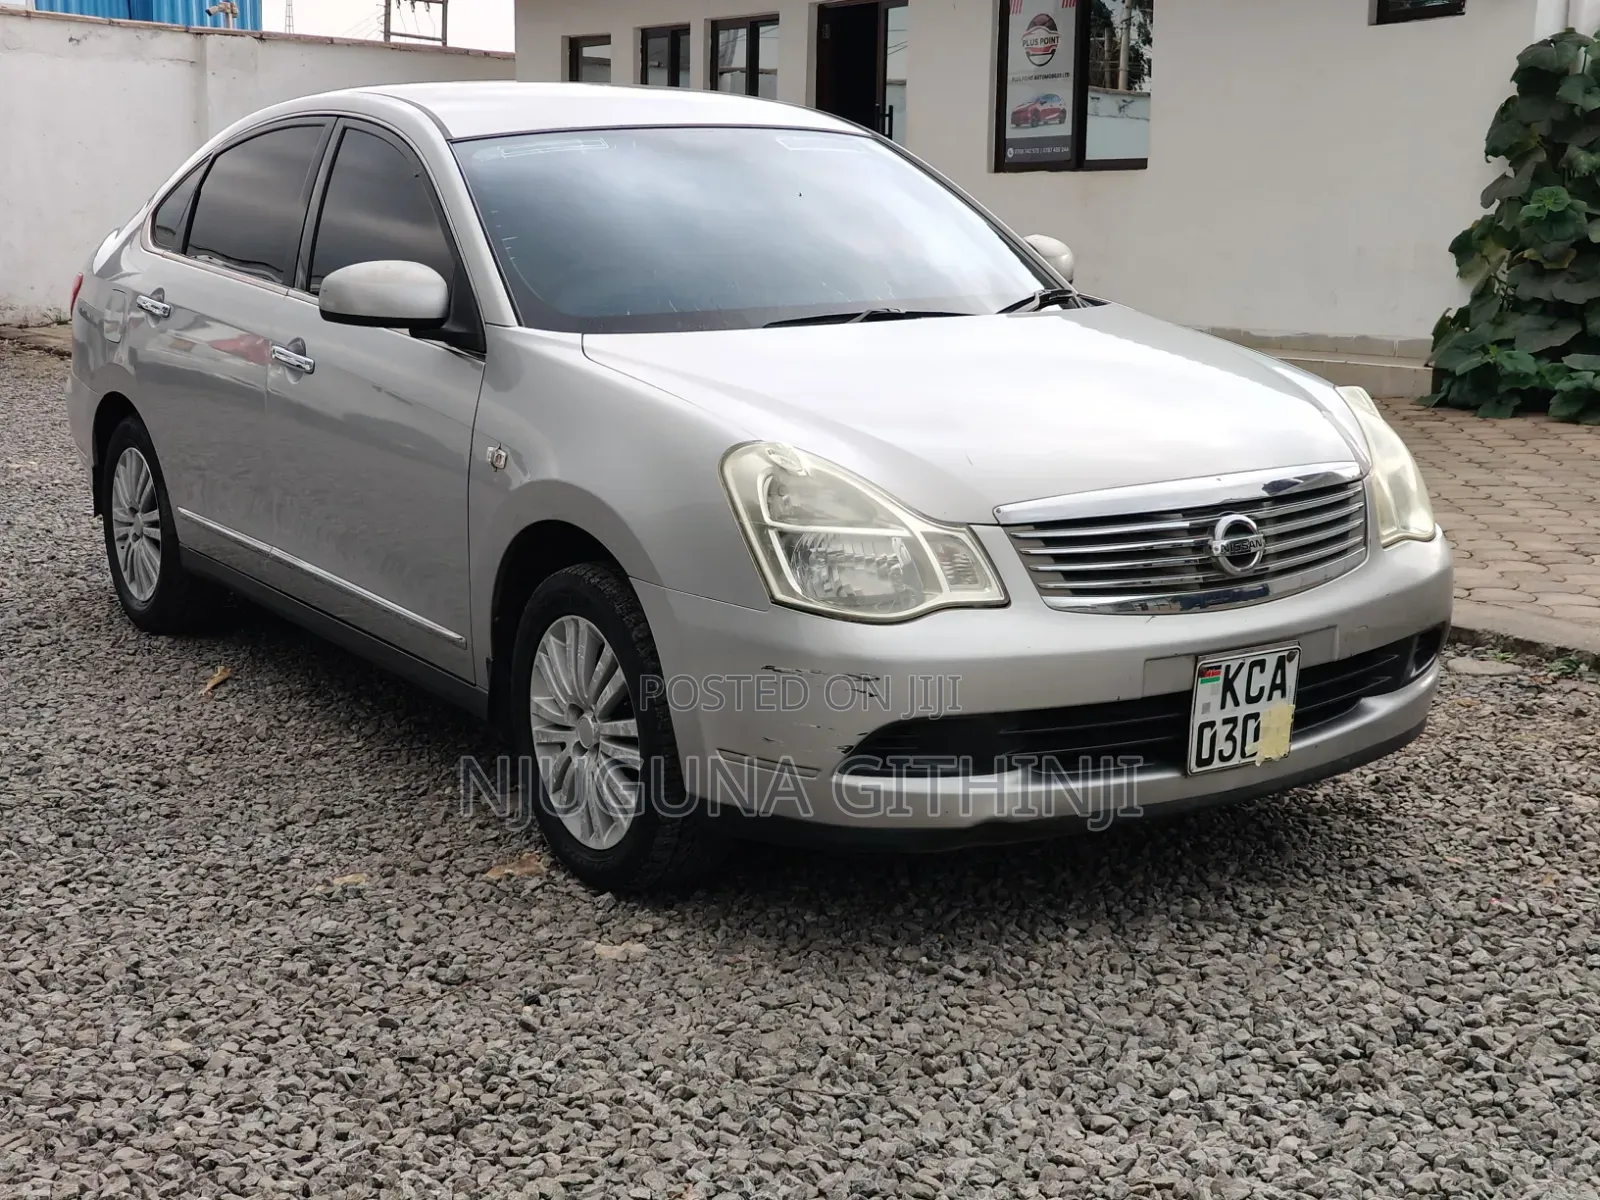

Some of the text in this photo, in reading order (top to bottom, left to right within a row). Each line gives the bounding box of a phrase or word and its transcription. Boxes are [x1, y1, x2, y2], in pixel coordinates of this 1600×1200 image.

[1022, 36, 1060, 47] PLUS POINT
[1220, 538, 1263, 553] NISSAN
[1220, 655, 1287, 710] KCA
[1196, 710, 1278, 768] 030
